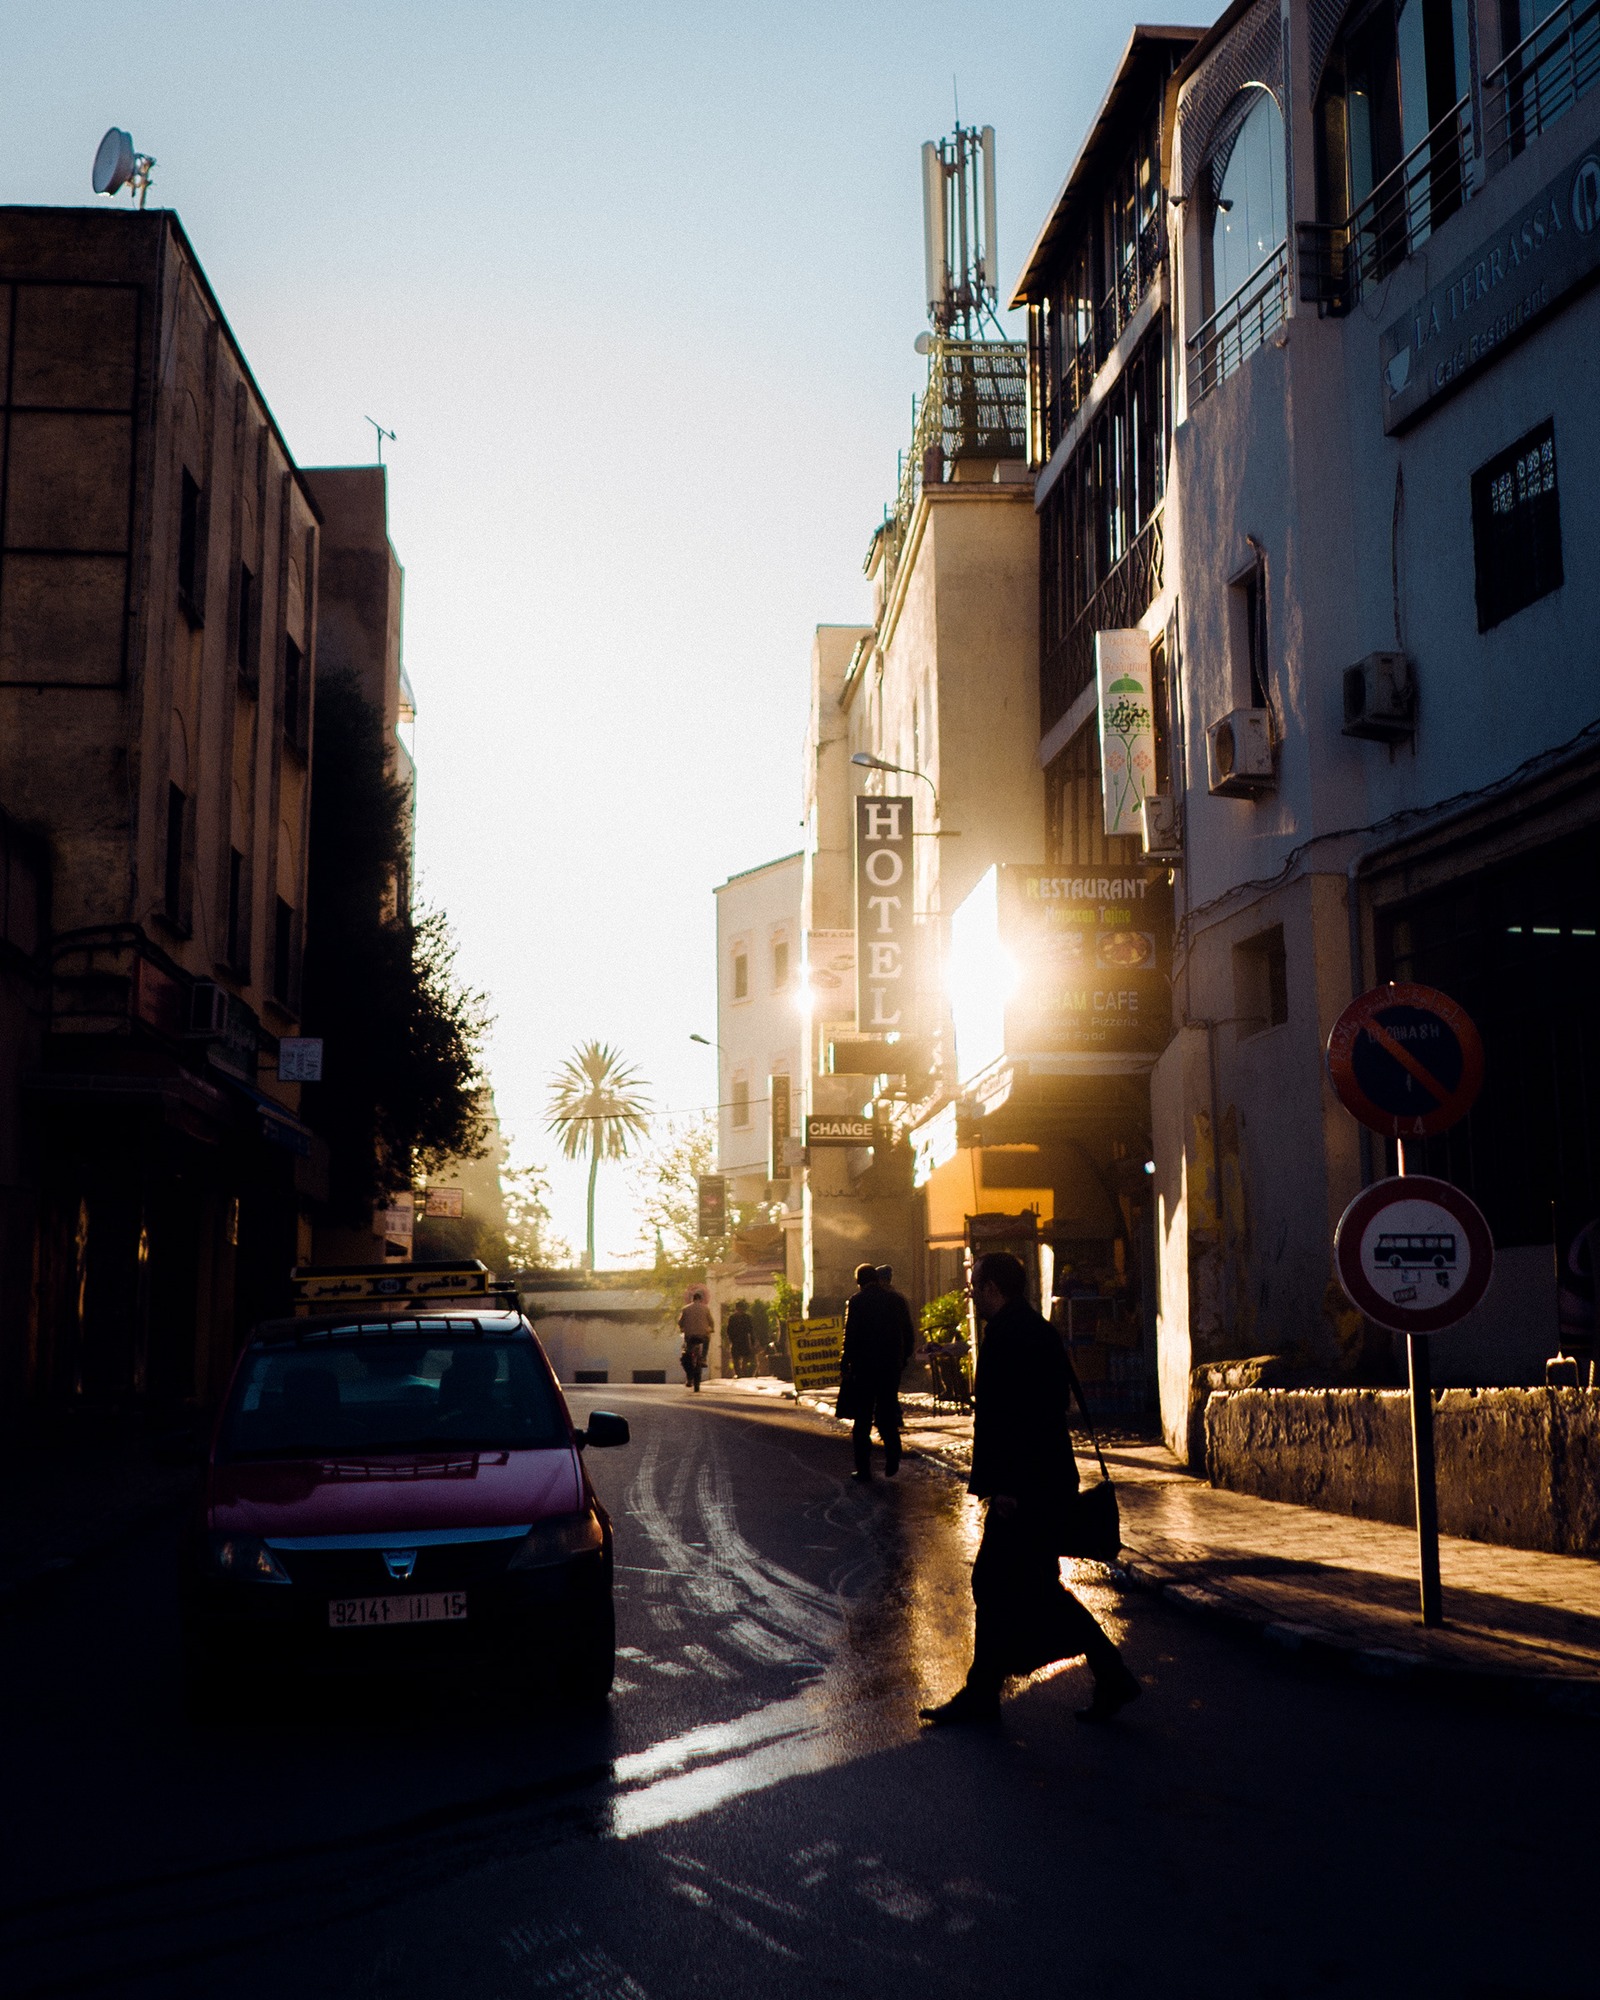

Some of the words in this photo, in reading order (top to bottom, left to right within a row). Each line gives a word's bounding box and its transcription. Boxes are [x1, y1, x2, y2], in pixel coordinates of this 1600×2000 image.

[1414, 301, 1441, 352] LA
[1445, 195, 1563, 323] TERRASSA
[1469, 279, 1549, 363] Restaurant
[1026, 878, 1148, 899] RESTAURANT
[865, 803, 903, 1025] HOTEL
[1093, 990, 1139, 1011] CAFE
[1090, 1015, 1139, 1028] Pizzeria
[809, 1122, 874, 1137] CHANGE
[792, 1318, 840, 1336] الصرف
[797, 1336, 838, 1348] Change
[798, 1349, 840, 1361] Cambio
